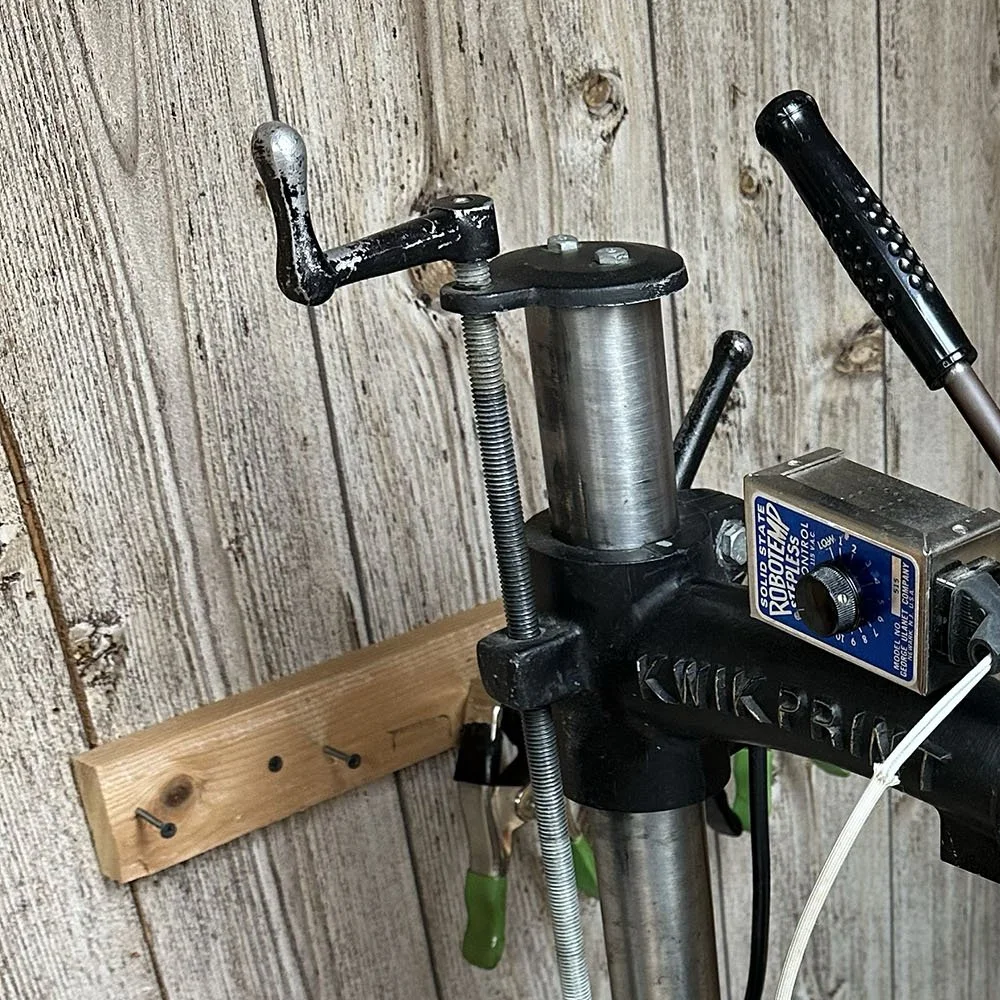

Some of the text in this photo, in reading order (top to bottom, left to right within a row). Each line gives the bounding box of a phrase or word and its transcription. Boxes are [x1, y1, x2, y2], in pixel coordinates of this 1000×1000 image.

[757, 503, 768, 608] SOLID STATE
[851, 544, 858, 553] 2
[766, 502, 792, 616] ROBOTEMP
[785, 535, 801, 608] STEPLESS
[877, 615, 885, 623] 6
[900, 561, 910, 678] GEORGE ULANET COMPANY
[850, 637, 857, 647] 9
[862, 635, 868, 644] 8
[873, 628, 879, 638] 7
[893, 640, 901, 671] MODEL
